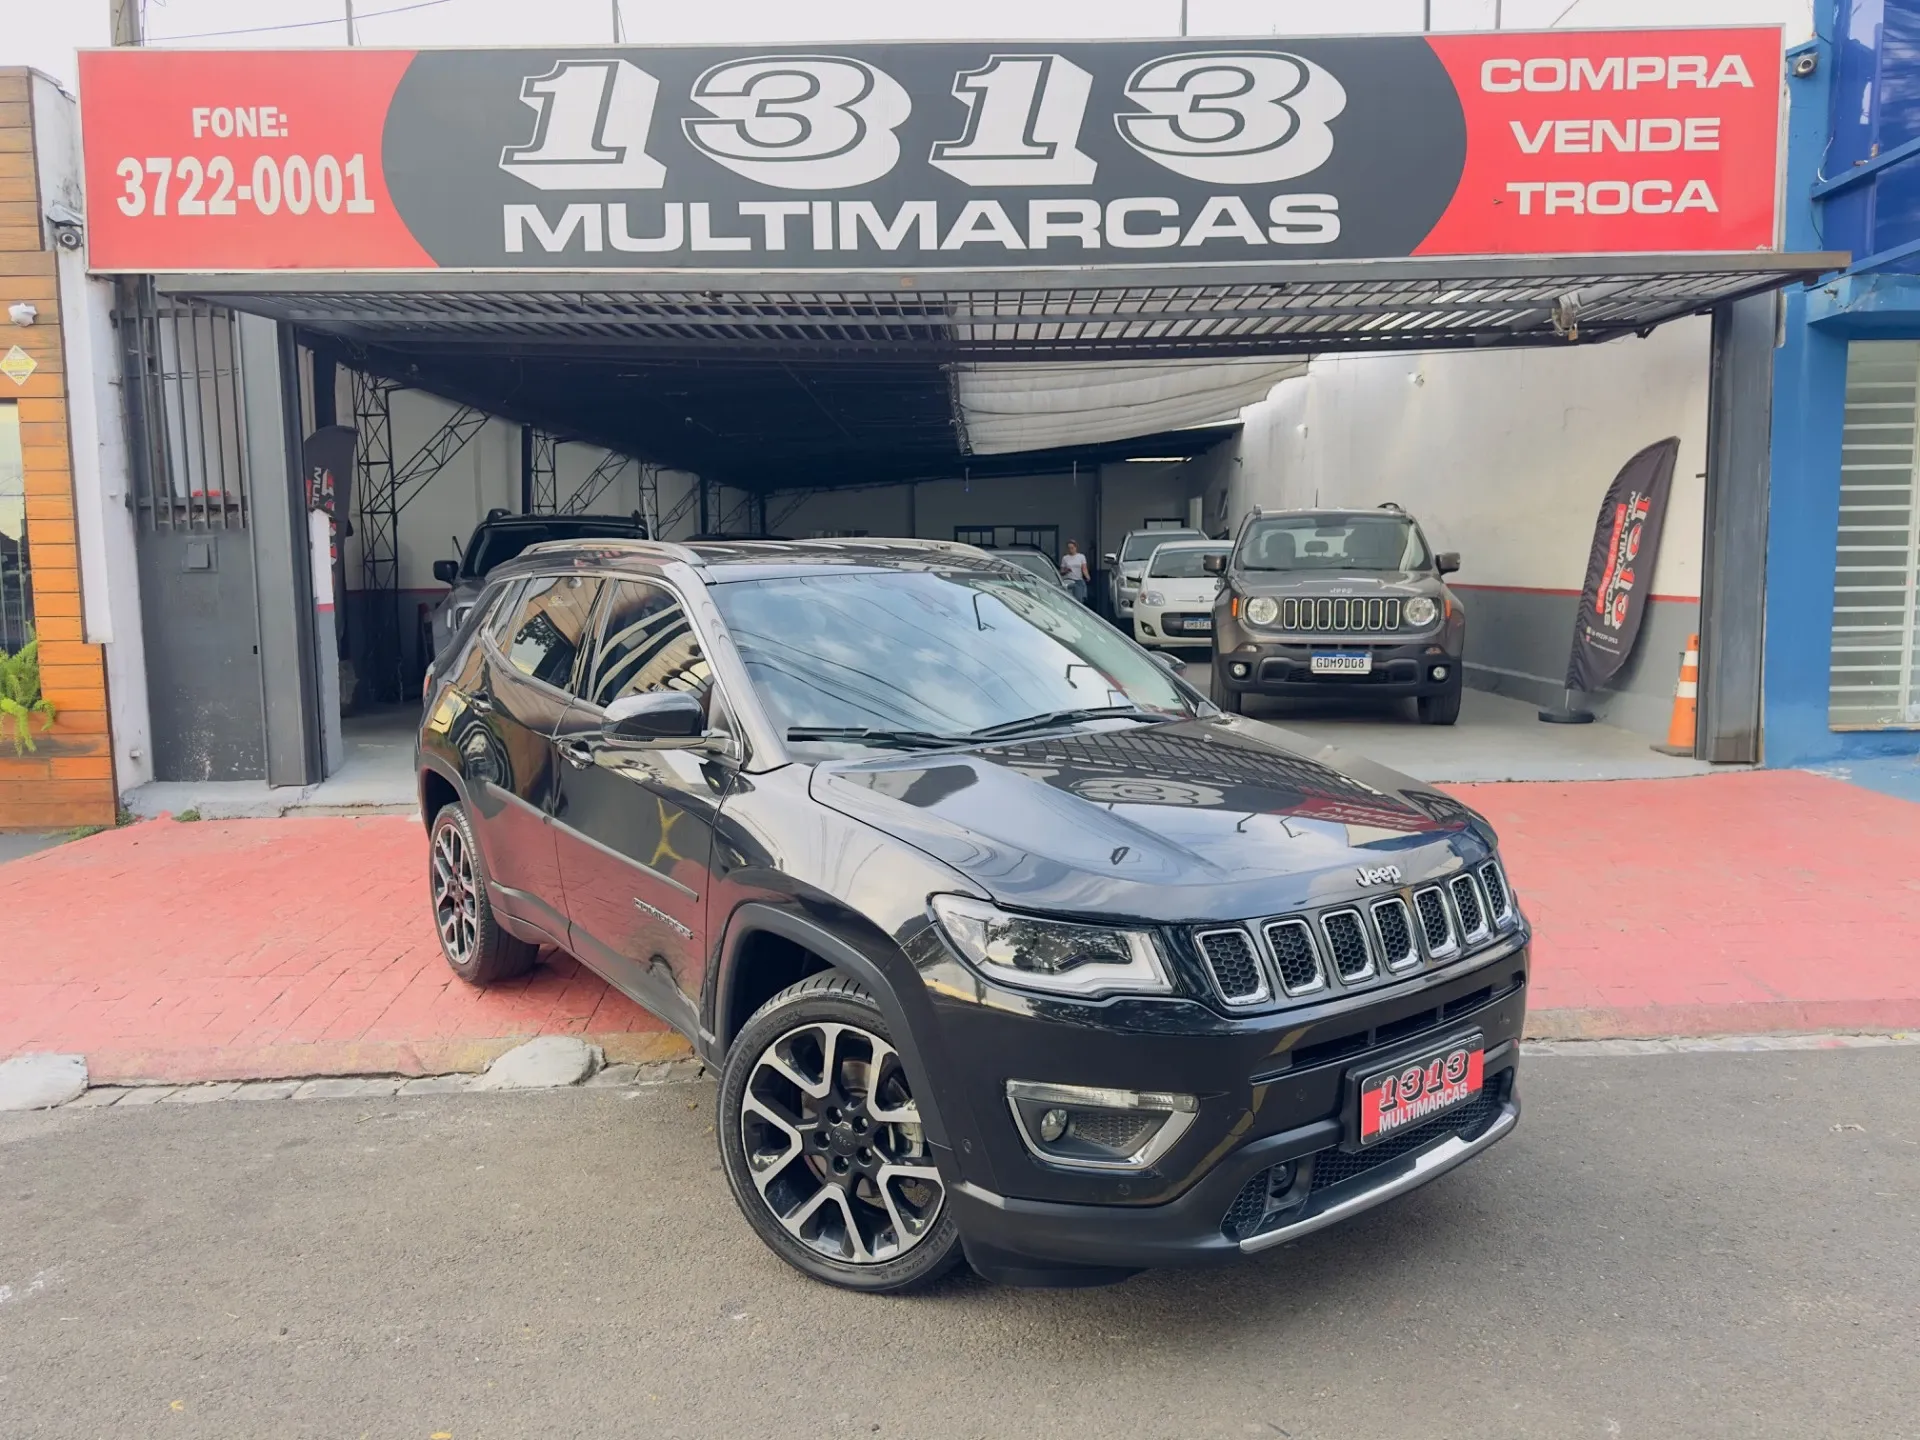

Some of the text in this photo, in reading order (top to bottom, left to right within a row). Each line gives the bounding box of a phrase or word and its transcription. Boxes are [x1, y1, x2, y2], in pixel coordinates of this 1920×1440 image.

[1482, 55, 1753, 93] COMPRA
[192, 106, 289, 138] FONE:
[498, 50, 1347, 191] 1313
[1509, 117, 1720, 153] VENDE
[116, 154, 374, 217] 3722-0001
[1507, 180, 1718, 214] TROCA
[503, 193, 1341, 254] MULTIMARCAS
[1356, 865, 1402, 888] Jeep
[1380, 1049, 1470, 1113] 1313
[1380, 1082, 1469, 1133] MULTIMARCAS
